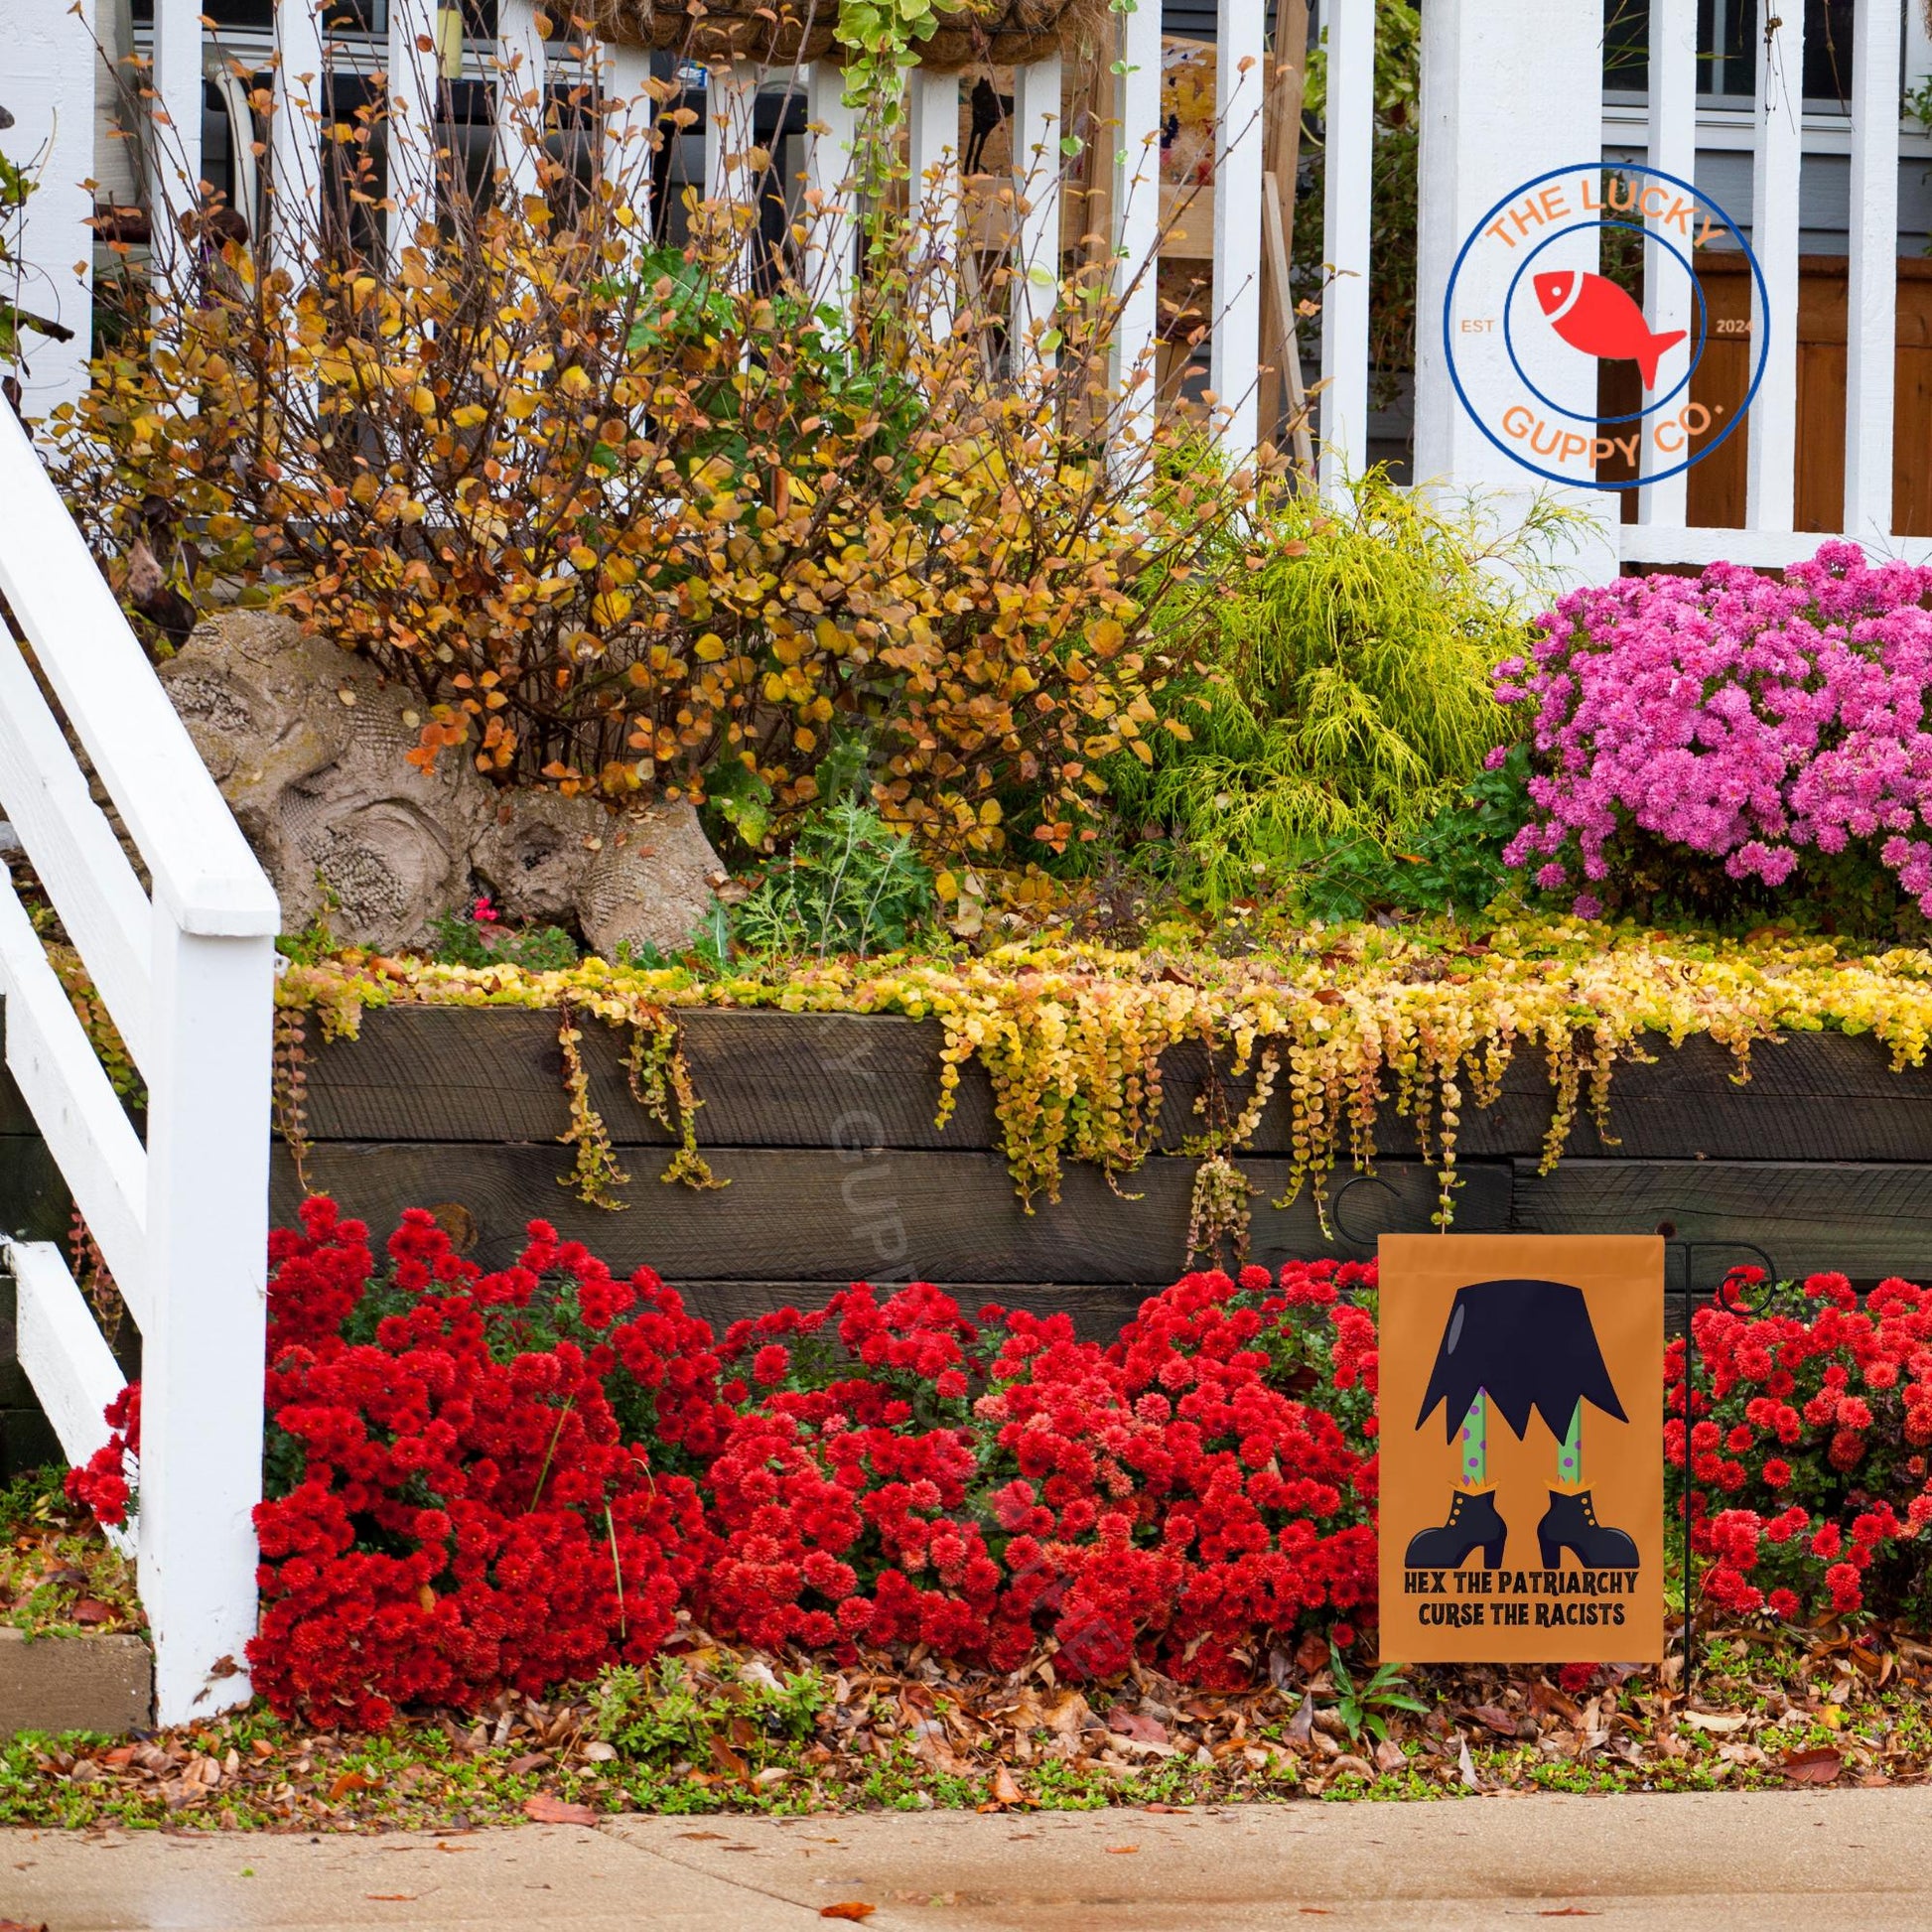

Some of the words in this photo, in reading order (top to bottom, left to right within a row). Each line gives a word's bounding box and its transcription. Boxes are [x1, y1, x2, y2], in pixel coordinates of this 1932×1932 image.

[1404, 1571, 1448, 1594] HEX
[1452, 1571, 1492, 1593] THE
[1498, 1571, 1640, 1596] PATRIARCHY
[1418, 1602, 1485, 1628] CURSE
[1489, 1602, 1529, 1625] THE
[1535, 1602, 1626, 1628] RACISTS
